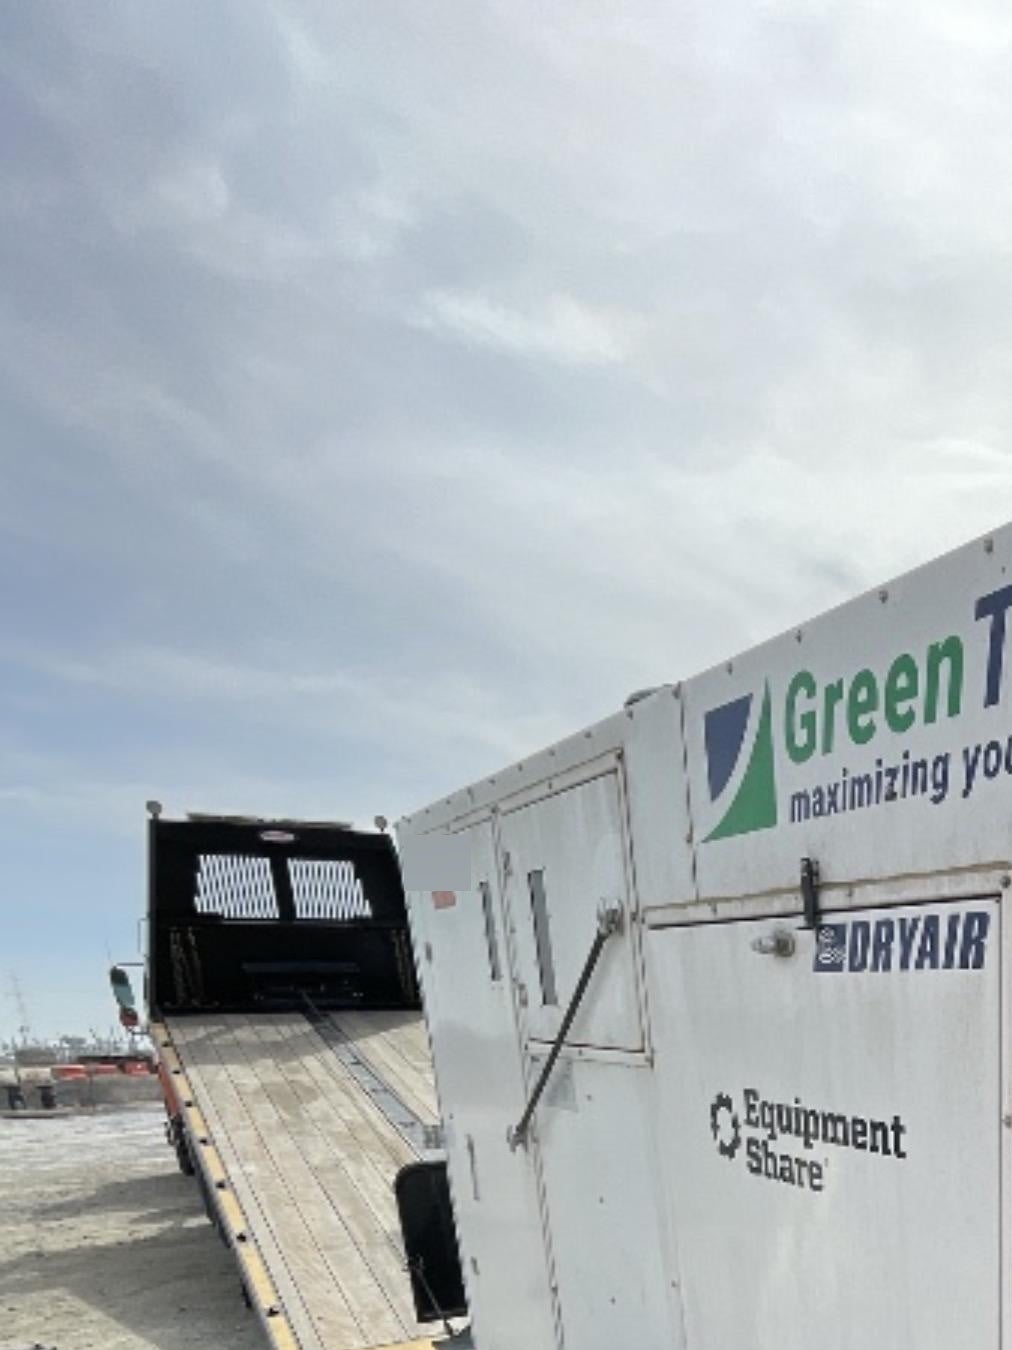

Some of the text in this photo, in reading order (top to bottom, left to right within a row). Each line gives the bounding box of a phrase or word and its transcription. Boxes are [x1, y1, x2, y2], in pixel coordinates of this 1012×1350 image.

[790, 750, 950, 824] maximizing
[848, 911, 991, 972] DRYAIR
[743, 1088, 907, 1159] Equipment
[745, 1136, 824, 1192] Share
